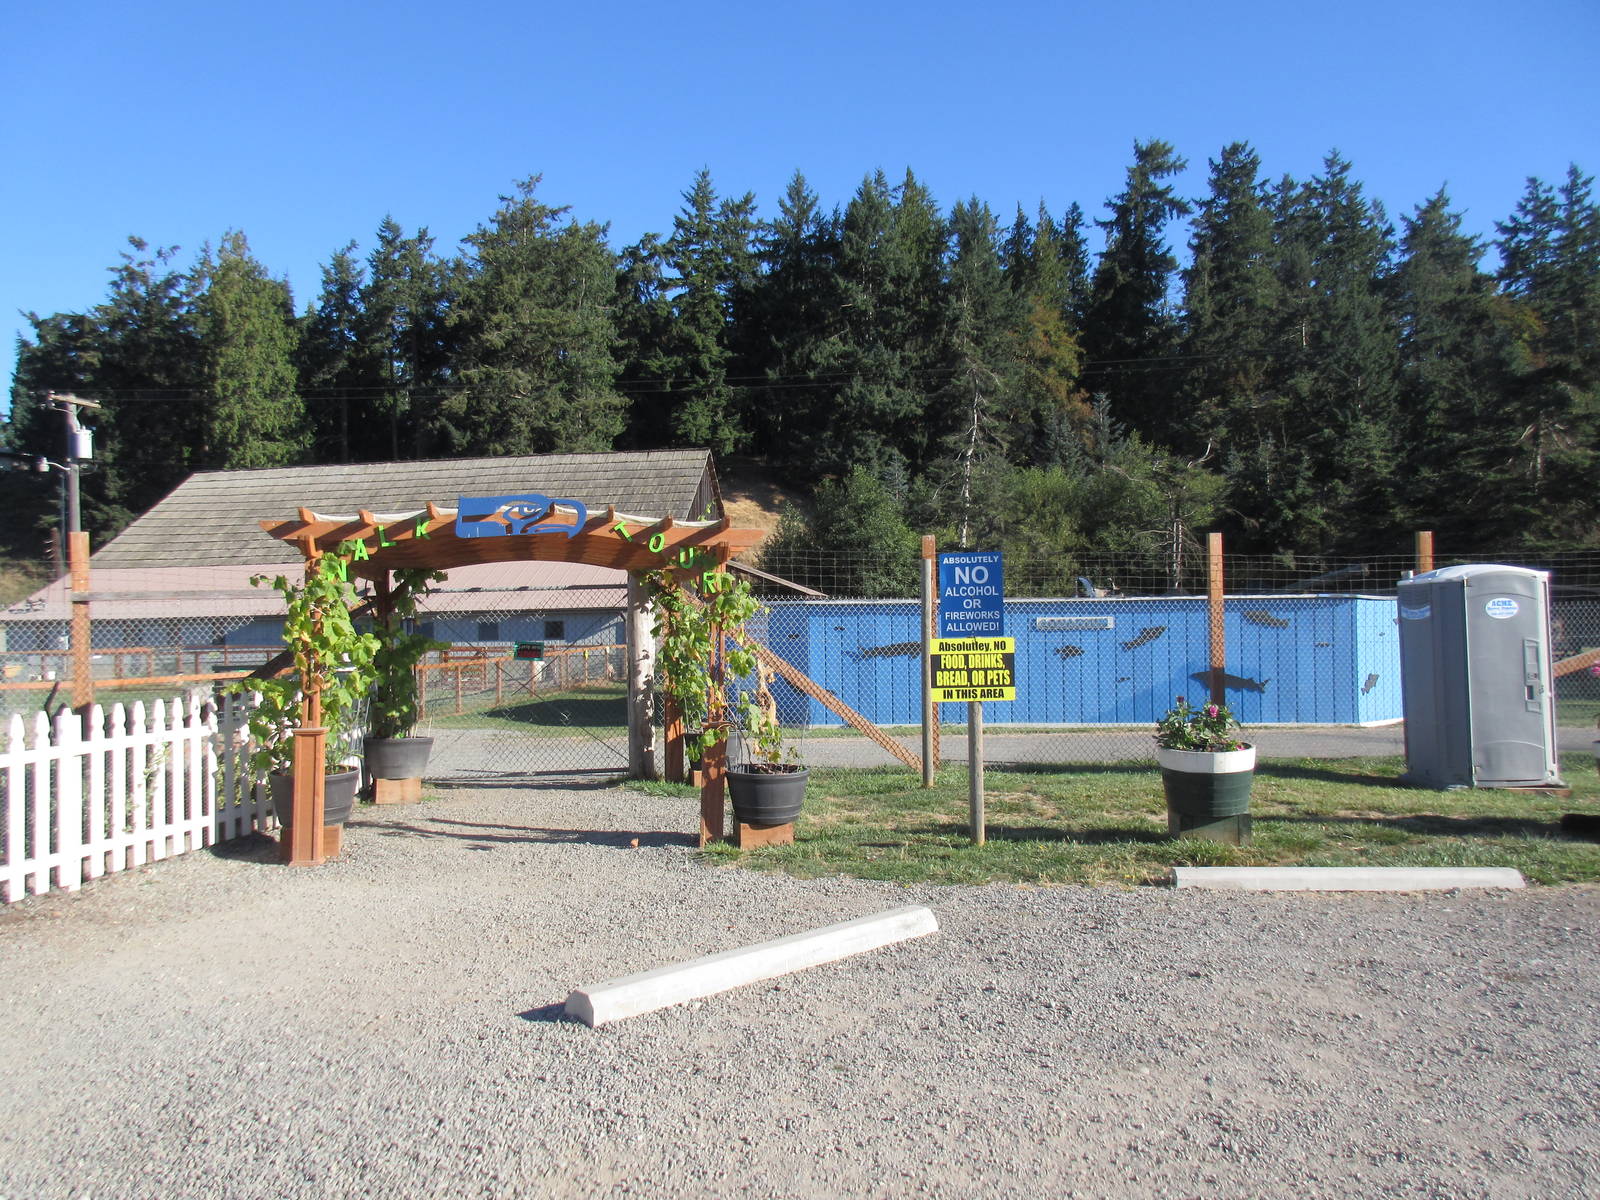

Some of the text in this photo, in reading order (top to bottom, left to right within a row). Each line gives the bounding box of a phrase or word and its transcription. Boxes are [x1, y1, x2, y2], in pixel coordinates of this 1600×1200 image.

[613, 520, 717, 594] TOUR
[943, 556, 999, 564] ABSOLUTELY
[954, 566, 989, 585] NO
[945, 586, 999, 597] ALCOHOL
[963, 599, 982, 609] OR
[945, 611, 1000, 620] FIREWORKS
[946, 622, 1000, 632] ALLOWED!
[993, 640, 1006, 650] NO
[940, 653, 1006, 670] FOOD, DRINKS,
[936, 669, 1011, 687] BREAD, OR PETS
[943, 688, 1005, 699] IN THIS AREA
